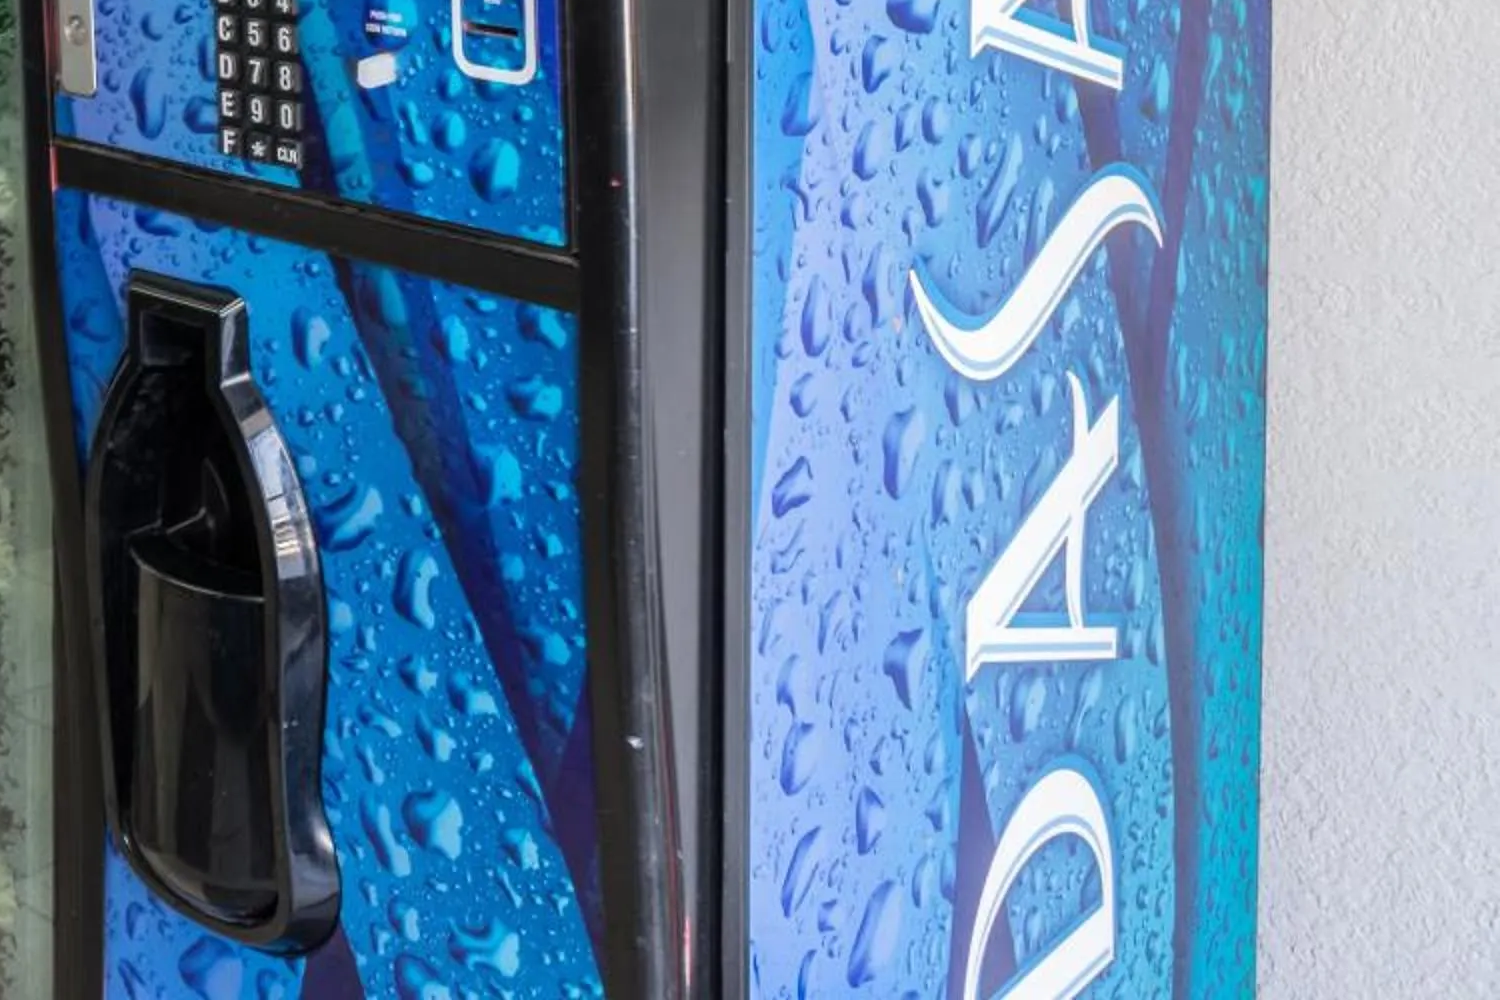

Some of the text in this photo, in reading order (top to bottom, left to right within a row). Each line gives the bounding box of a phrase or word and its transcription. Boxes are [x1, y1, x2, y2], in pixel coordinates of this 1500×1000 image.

[218, 16, 290, 52] C 5 6
[219, 54, 291, 90] D 7 8
[221, 91, 292, 129] E 9 0
[222, 130, 236, 155] F
